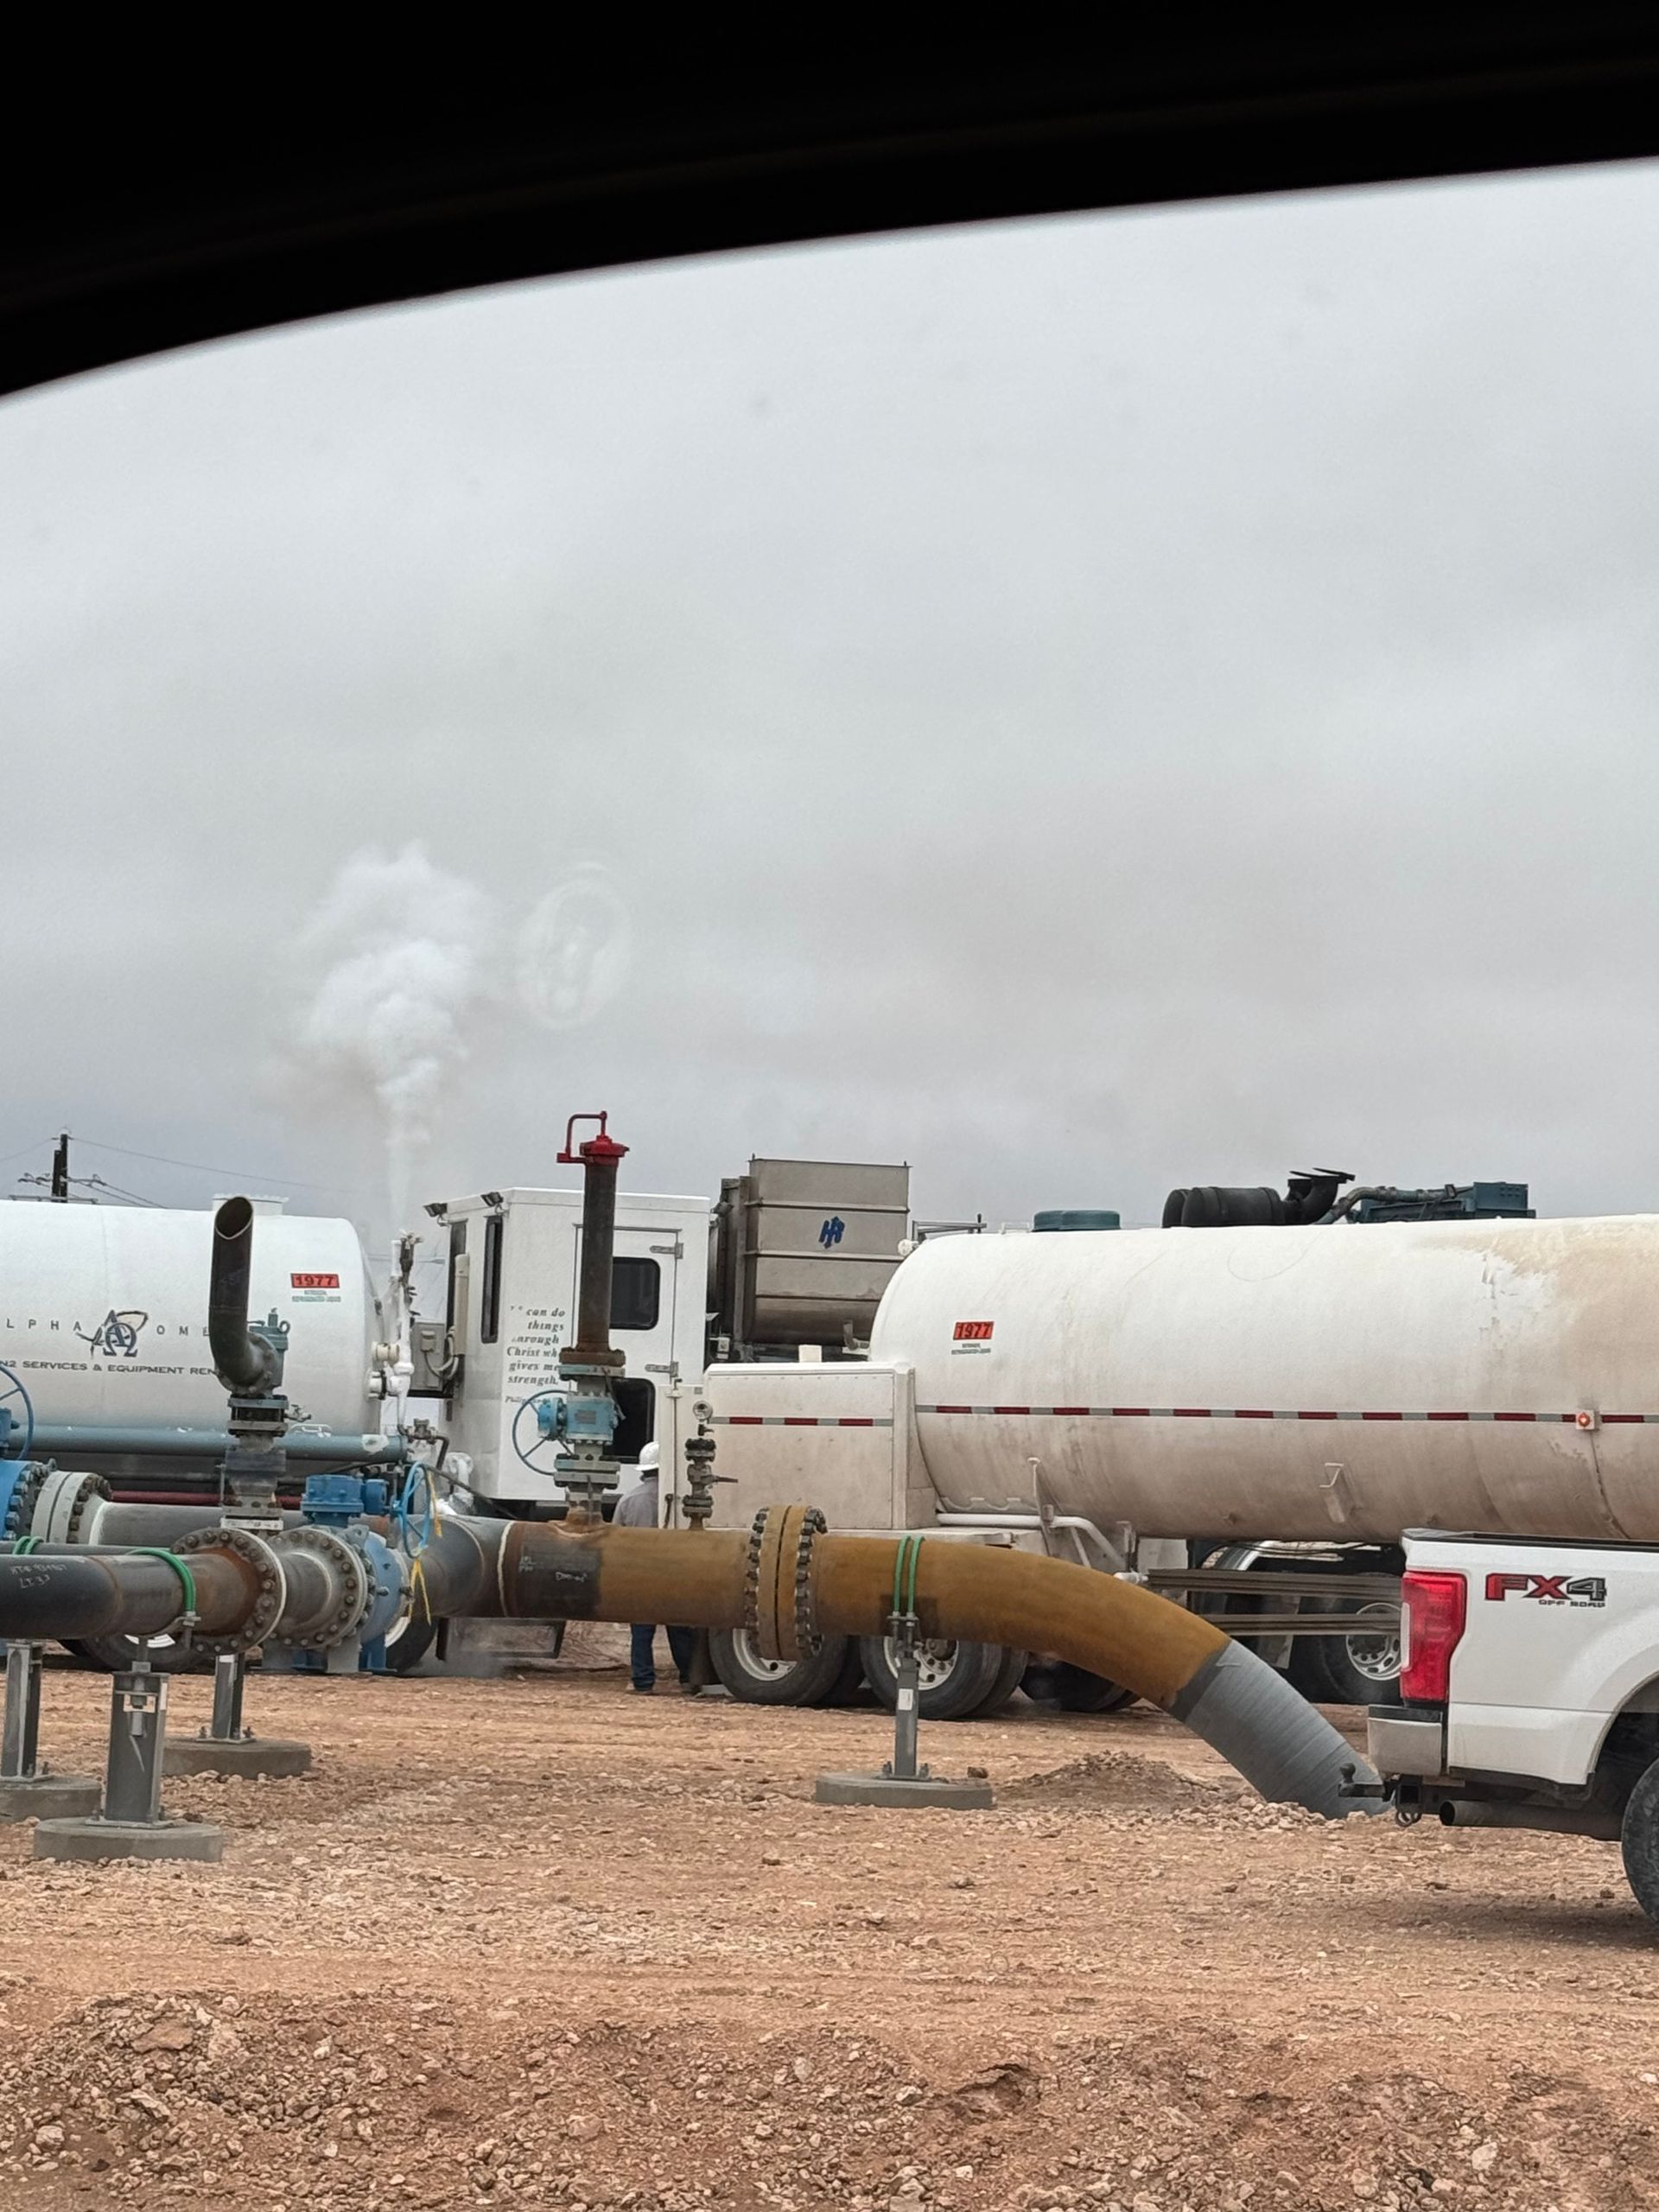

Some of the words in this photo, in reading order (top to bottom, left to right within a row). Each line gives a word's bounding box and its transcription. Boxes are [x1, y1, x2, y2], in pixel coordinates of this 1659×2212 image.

[294, 1274, 335, 1287] 1977
[551, 1307, 566, 1317] do
[527, 1319, 564, 1332] things
[957, 1322, 992, 1338] 1977
[507, 1346, 540, 1357] Christ
[22, 1360, 88, 1371] SERVICES
[92, 1363, 103, 1372] &
[107, 1364, 185, 1375] EQUIPMENT
[508, 1359, 539, 1372] gives
[1484, 1573, 1607, 1602] FX4
